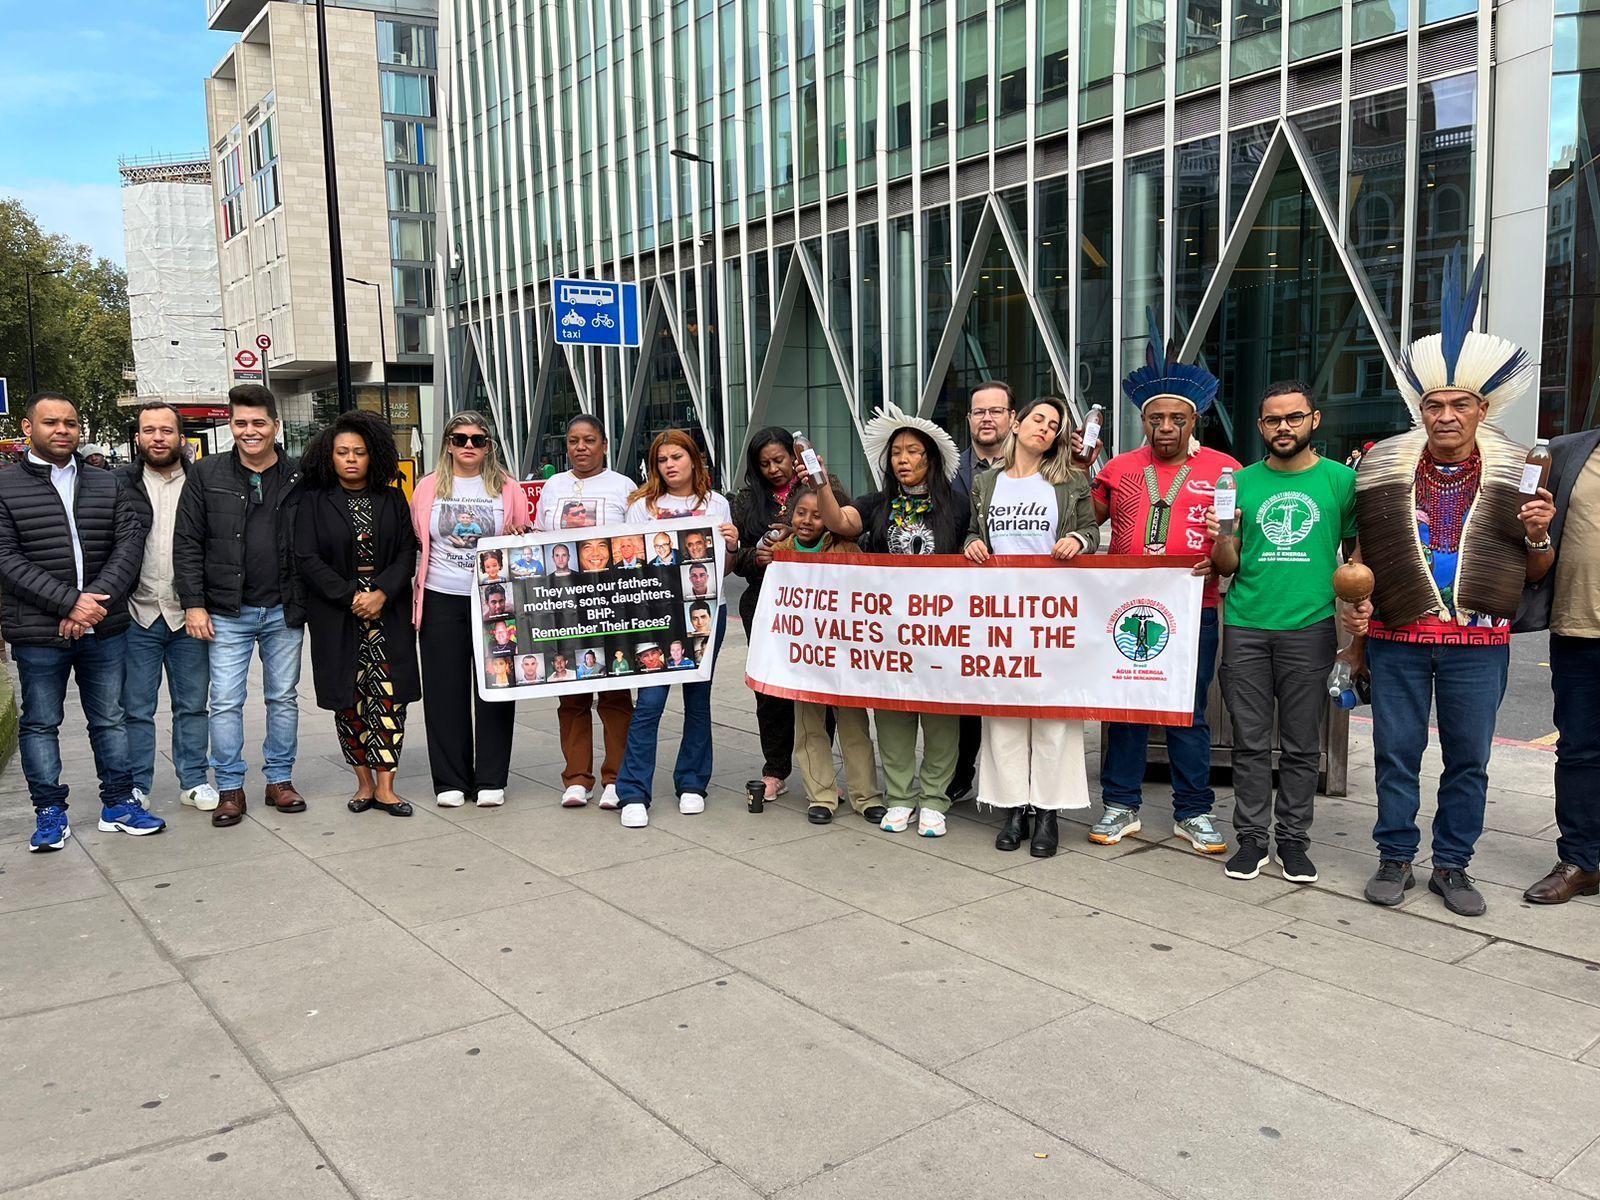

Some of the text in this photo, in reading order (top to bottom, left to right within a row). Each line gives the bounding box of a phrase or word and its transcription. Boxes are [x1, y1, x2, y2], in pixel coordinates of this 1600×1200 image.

[257, 336, 269, 348] G
[562, 329, 581, 339] taxi
[988, 501, 1048, 518] Revida
[445, 553, 464, 561] Para
[533, 576, 662, 598] They were our fathers,
[523, 588, 675, 612] mothers, sons, daughters.
[774, 586, 1078, 618] JUSTICE FOR BHP BILLITON
[586, 608, 616, 621] BHP:
[531, 614, 672, 639] Remember Their Faces?
[770, 613, 1076, 649] AND VALE'S CRIME IN THE
[789, 642, 837, 668] DOCE
[849, 648, 914, 674] RIVER
[960, 655, 1042, 678] BRAZIL
